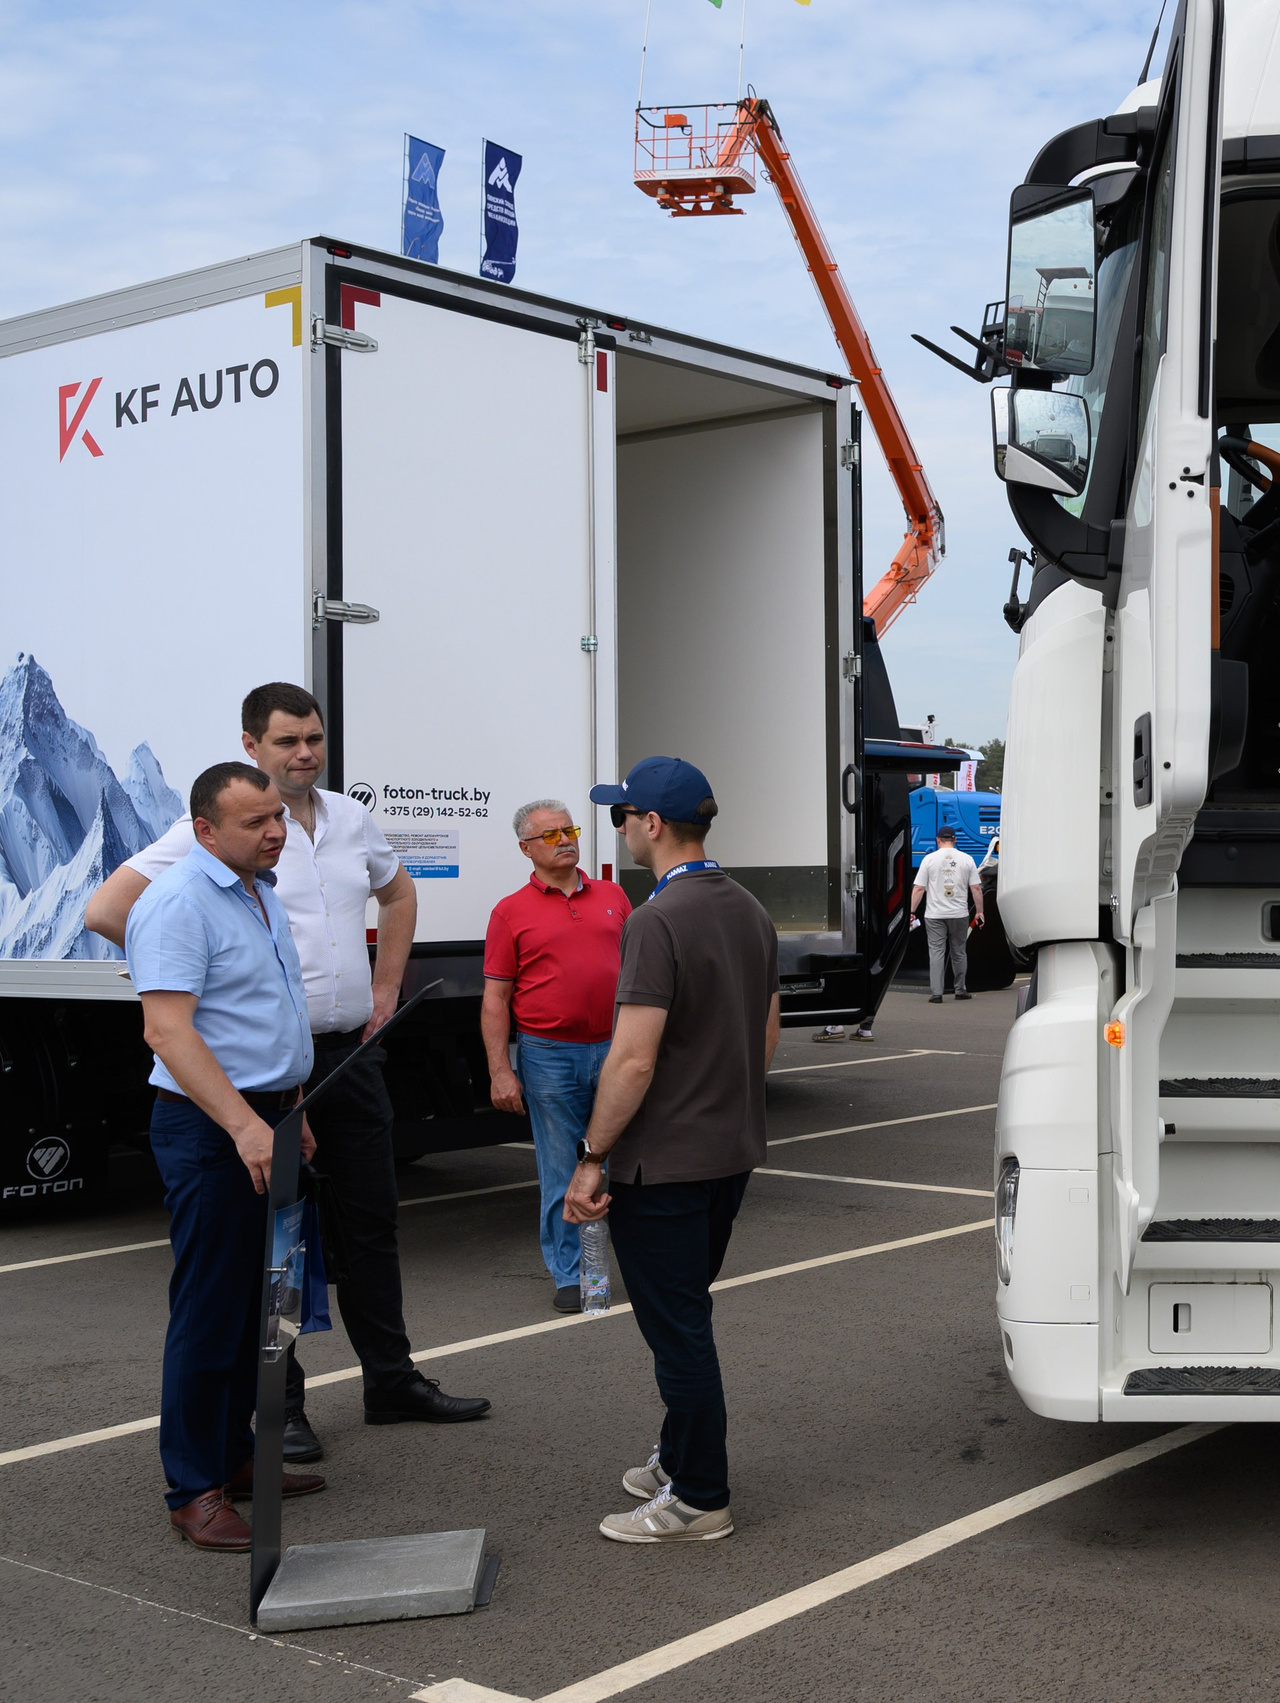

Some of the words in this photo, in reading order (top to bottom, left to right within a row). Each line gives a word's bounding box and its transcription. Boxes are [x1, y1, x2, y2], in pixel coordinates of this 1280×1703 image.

[115, 383, 160, 428] KF
[170, 358, 280, 417] AUTO
[383, 784, 491, 805] foton-truck.by
[383, 806, 410, 816] +375
[412, 806, 434, 819] (29)
[437, 807, 489, 818] 142-52-62
[666, 865, 688, 880] KAMAZ
[3, 1178, 83, 1199] FOTON
